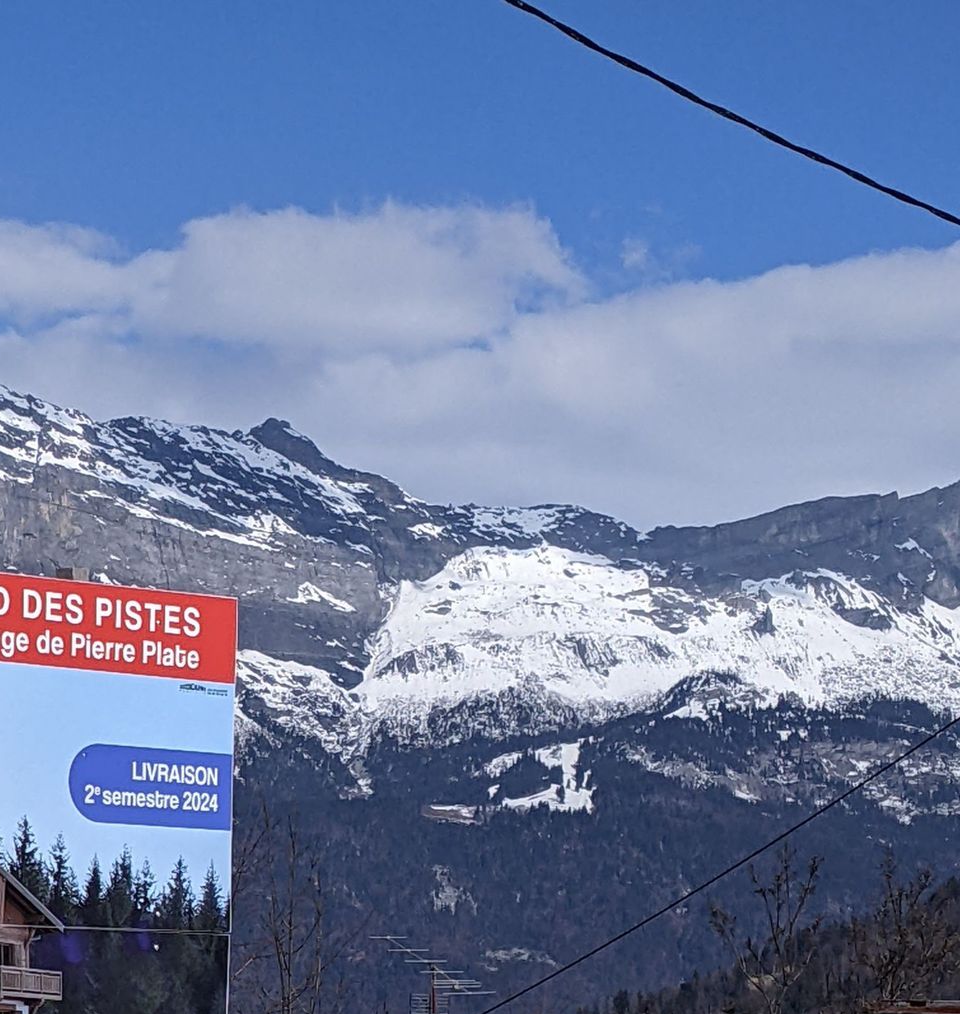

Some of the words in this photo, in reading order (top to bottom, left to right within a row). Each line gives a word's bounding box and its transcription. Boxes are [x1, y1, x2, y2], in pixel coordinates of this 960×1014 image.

[22, 588, 84, 625] DES
[95, 597, 201, 638] PISTES
[36, 629, 64, 656] de
[71, 633, 136, 663] Pierre
[142, 640, 200, 669] Plate
[132, 761, 218, 786] LIVRAISON
[102, 789, 180, 810] semestre
[182, 791, 218, 812] 2024
